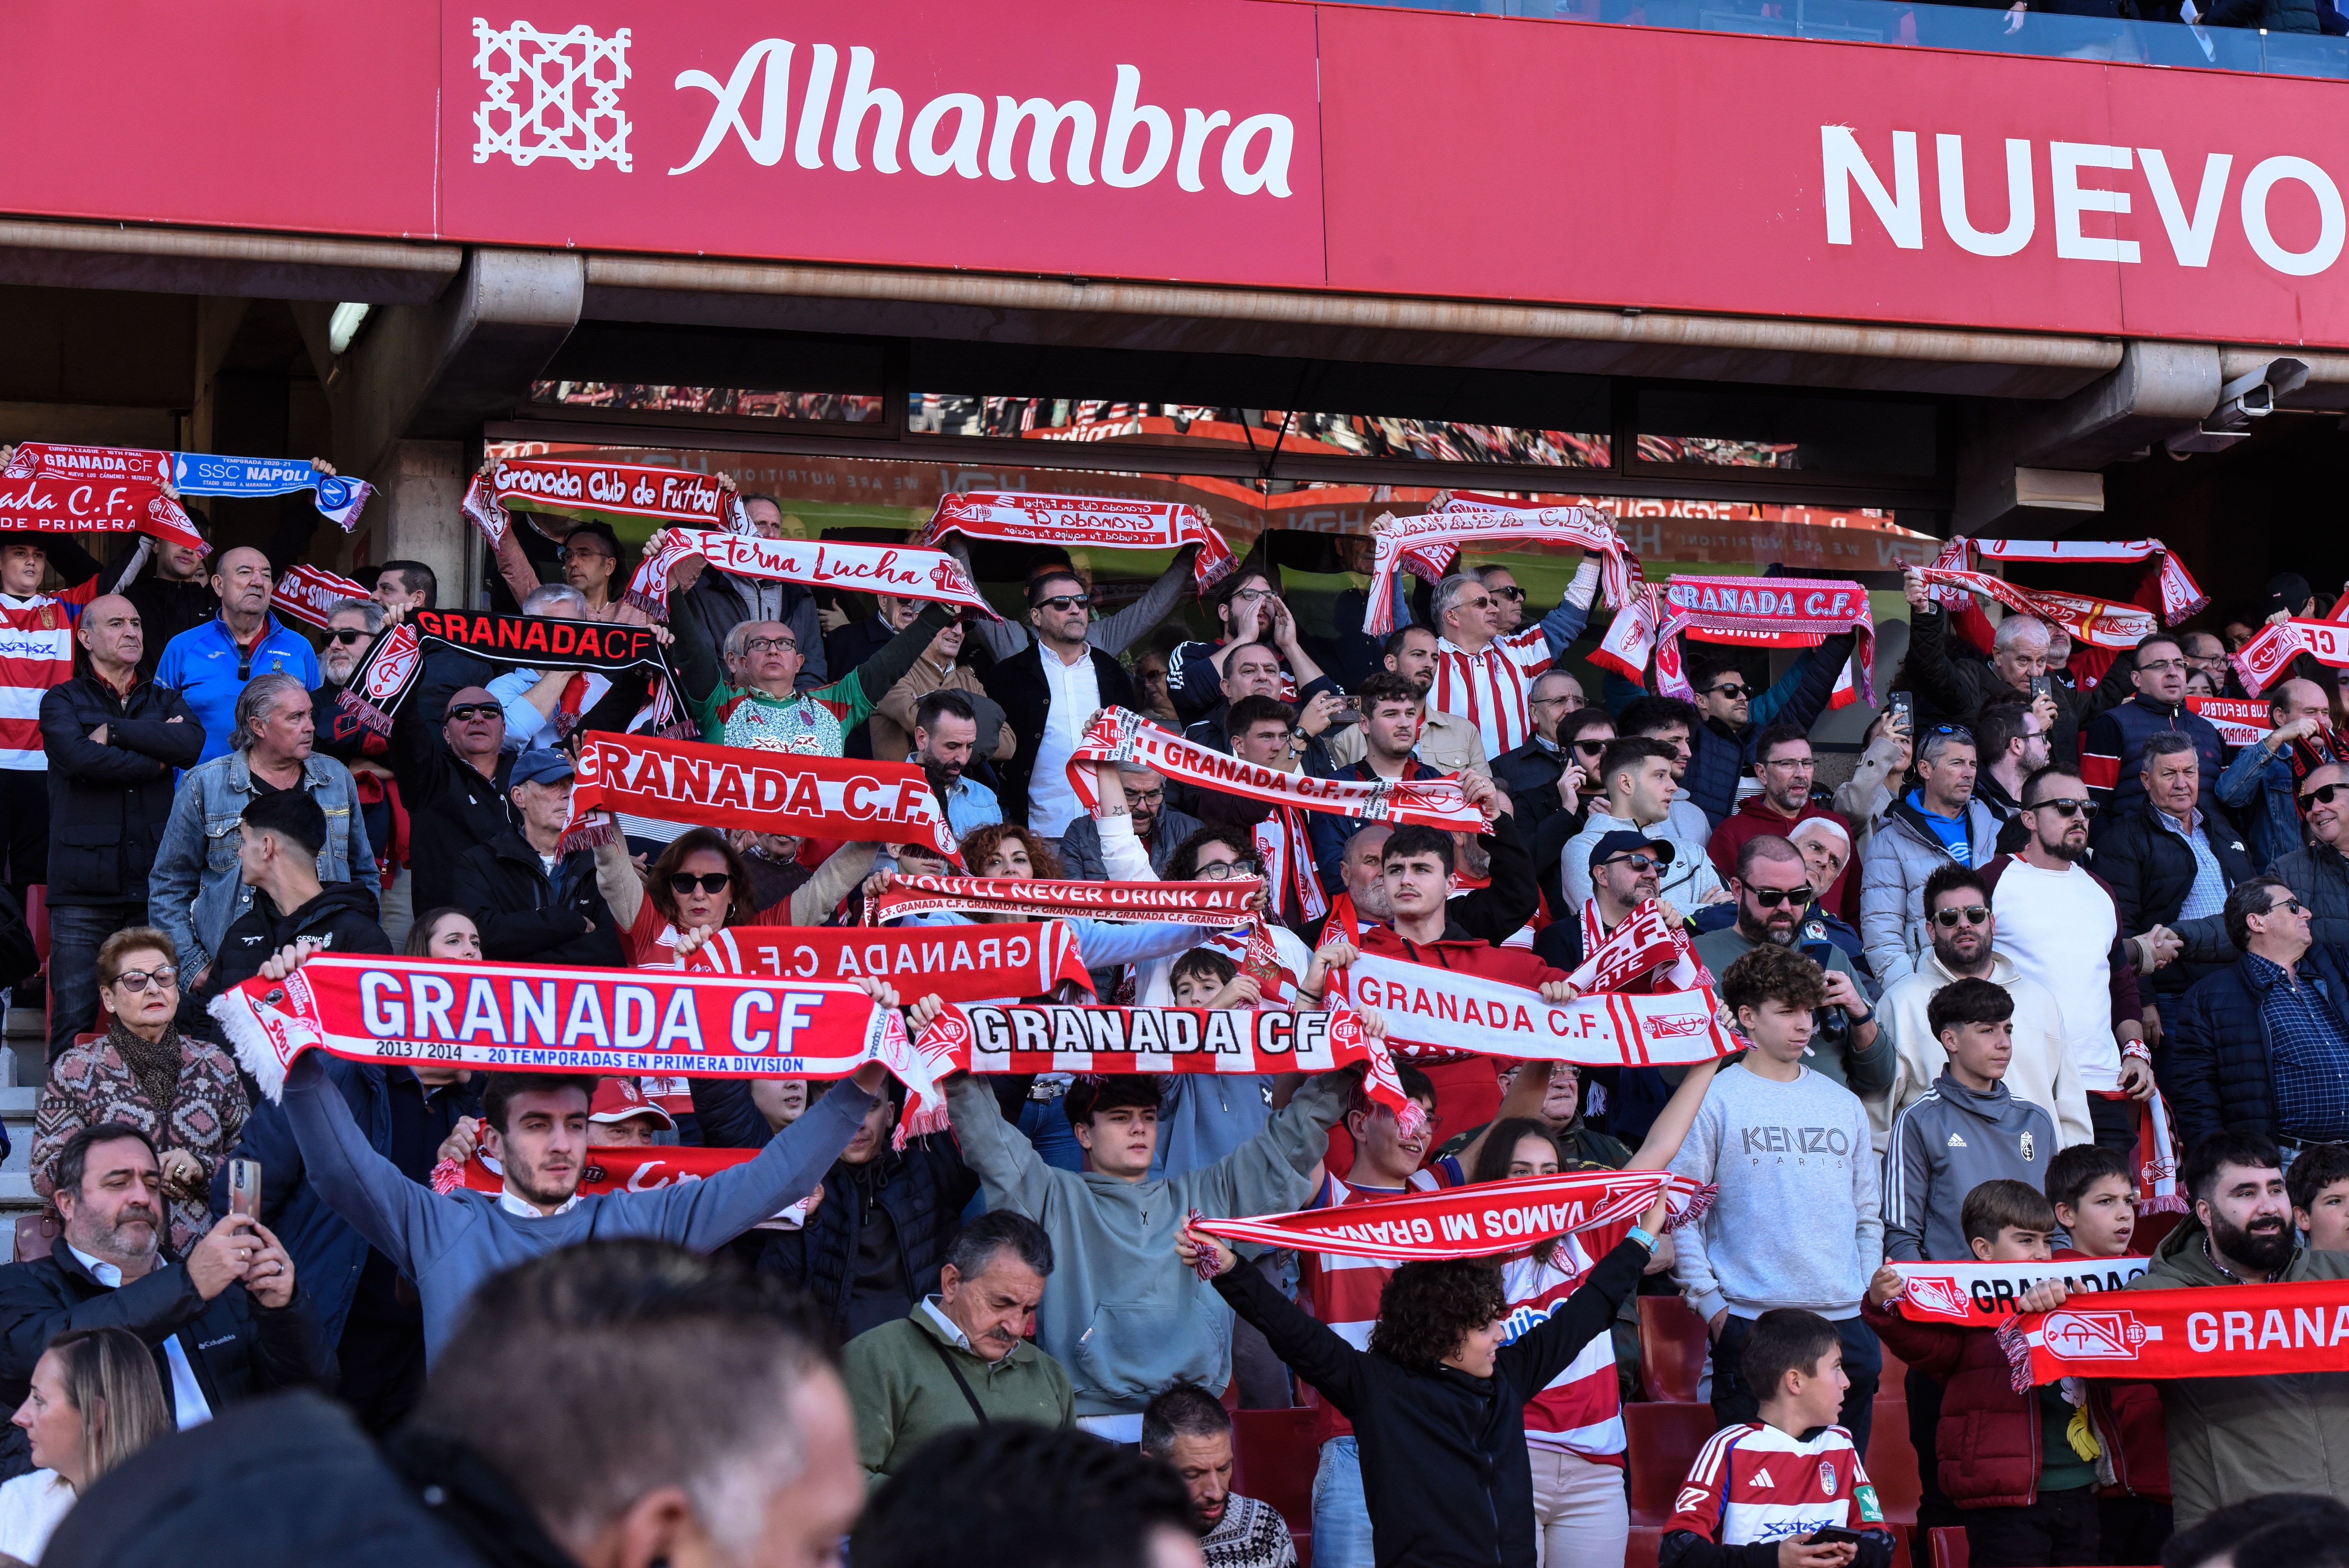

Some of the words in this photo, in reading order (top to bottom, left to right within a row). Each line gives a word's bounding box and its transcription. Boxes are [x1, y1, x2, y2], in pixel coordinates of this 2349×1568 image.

[668, 37, 1294, 198] Alhambra
[1820, 122, 2346, 276] NUEVO
[199, 463, 240, 479] SSC
[246, 467, 310, 481] NAPOLI
[494, 464, 583, 499] Granada
[588, 470, 626, 503] Club
[632, 475, 655, 506] de
[663, 477, 721, 514] Fútbol
[68, 485, 133, 516] C.F.
[0, 517, 28, 528] DE
[39, 519, 135, 530] PRIMERA
[698, 533, 801, 573] Eterna
[812, 546, 924, 585] Lucha
[1668, 584, 1796, 616] GRANADA
[1804, 592, 1856, 617] C.F.
[575, 739, 826, 819] GRANADA
[841, 775, 930, 826] C.F.
[1164, 741, 1287, 793] GRANADA
[1295, 777, 1340, 800] C.F.
[895, 874, 1005, 898] YOU'LL
[1011, 883, 1104, 903] NEVER
[1110, 887, 1199, 908] DRINK
[896, 899, 943, 913] GRANADA
[946, 899, 964, 908] C.F.
[966, 899, 1016, 912] GRANADA
[1020, 904, 1039, 913] C.F.
[1041, 906, 1093, 917] GRANADA
[1095, 910, 1114, 918] C.F.
[1116, 911, 1166, 922] GRANADA
[1167, 913, 1185, 923] C.F.
[1187, 914, 1235, 925] GRANADA
[1596, 917, 1668, 976] C.F.
[359, 970, 705, 1051] GRANADA
[730, 989, 824, 1053] CF
[1358, 978, 1534, 1034] GRANADA
[1547, 1007, 1609, 1041] C.F.
[977, 1008, 1241, 1055] GRANADA
[1258, 1010, 1328, 1055] CF
[376, 1041, 413, 1057] 2013
[428, 1044, 462, 1060] 2014
[488, 1048, 507, 1063] 20
[511, 1049, 622, 1067] TEMPORADAS
[627, 1055, 647, 1069] EN
[654, 1056, 729, 1071] PRIMERA
[734, 1055, 804, 1072] DIVISIÓN
[1741, 1126, 1849, 1156] KENZO
[1753, 1156, 1843, 1169] PARIS
[1438, 1212, 1479, 1241] MI
[1486, 1200, 1586, 1238] VAMOS
